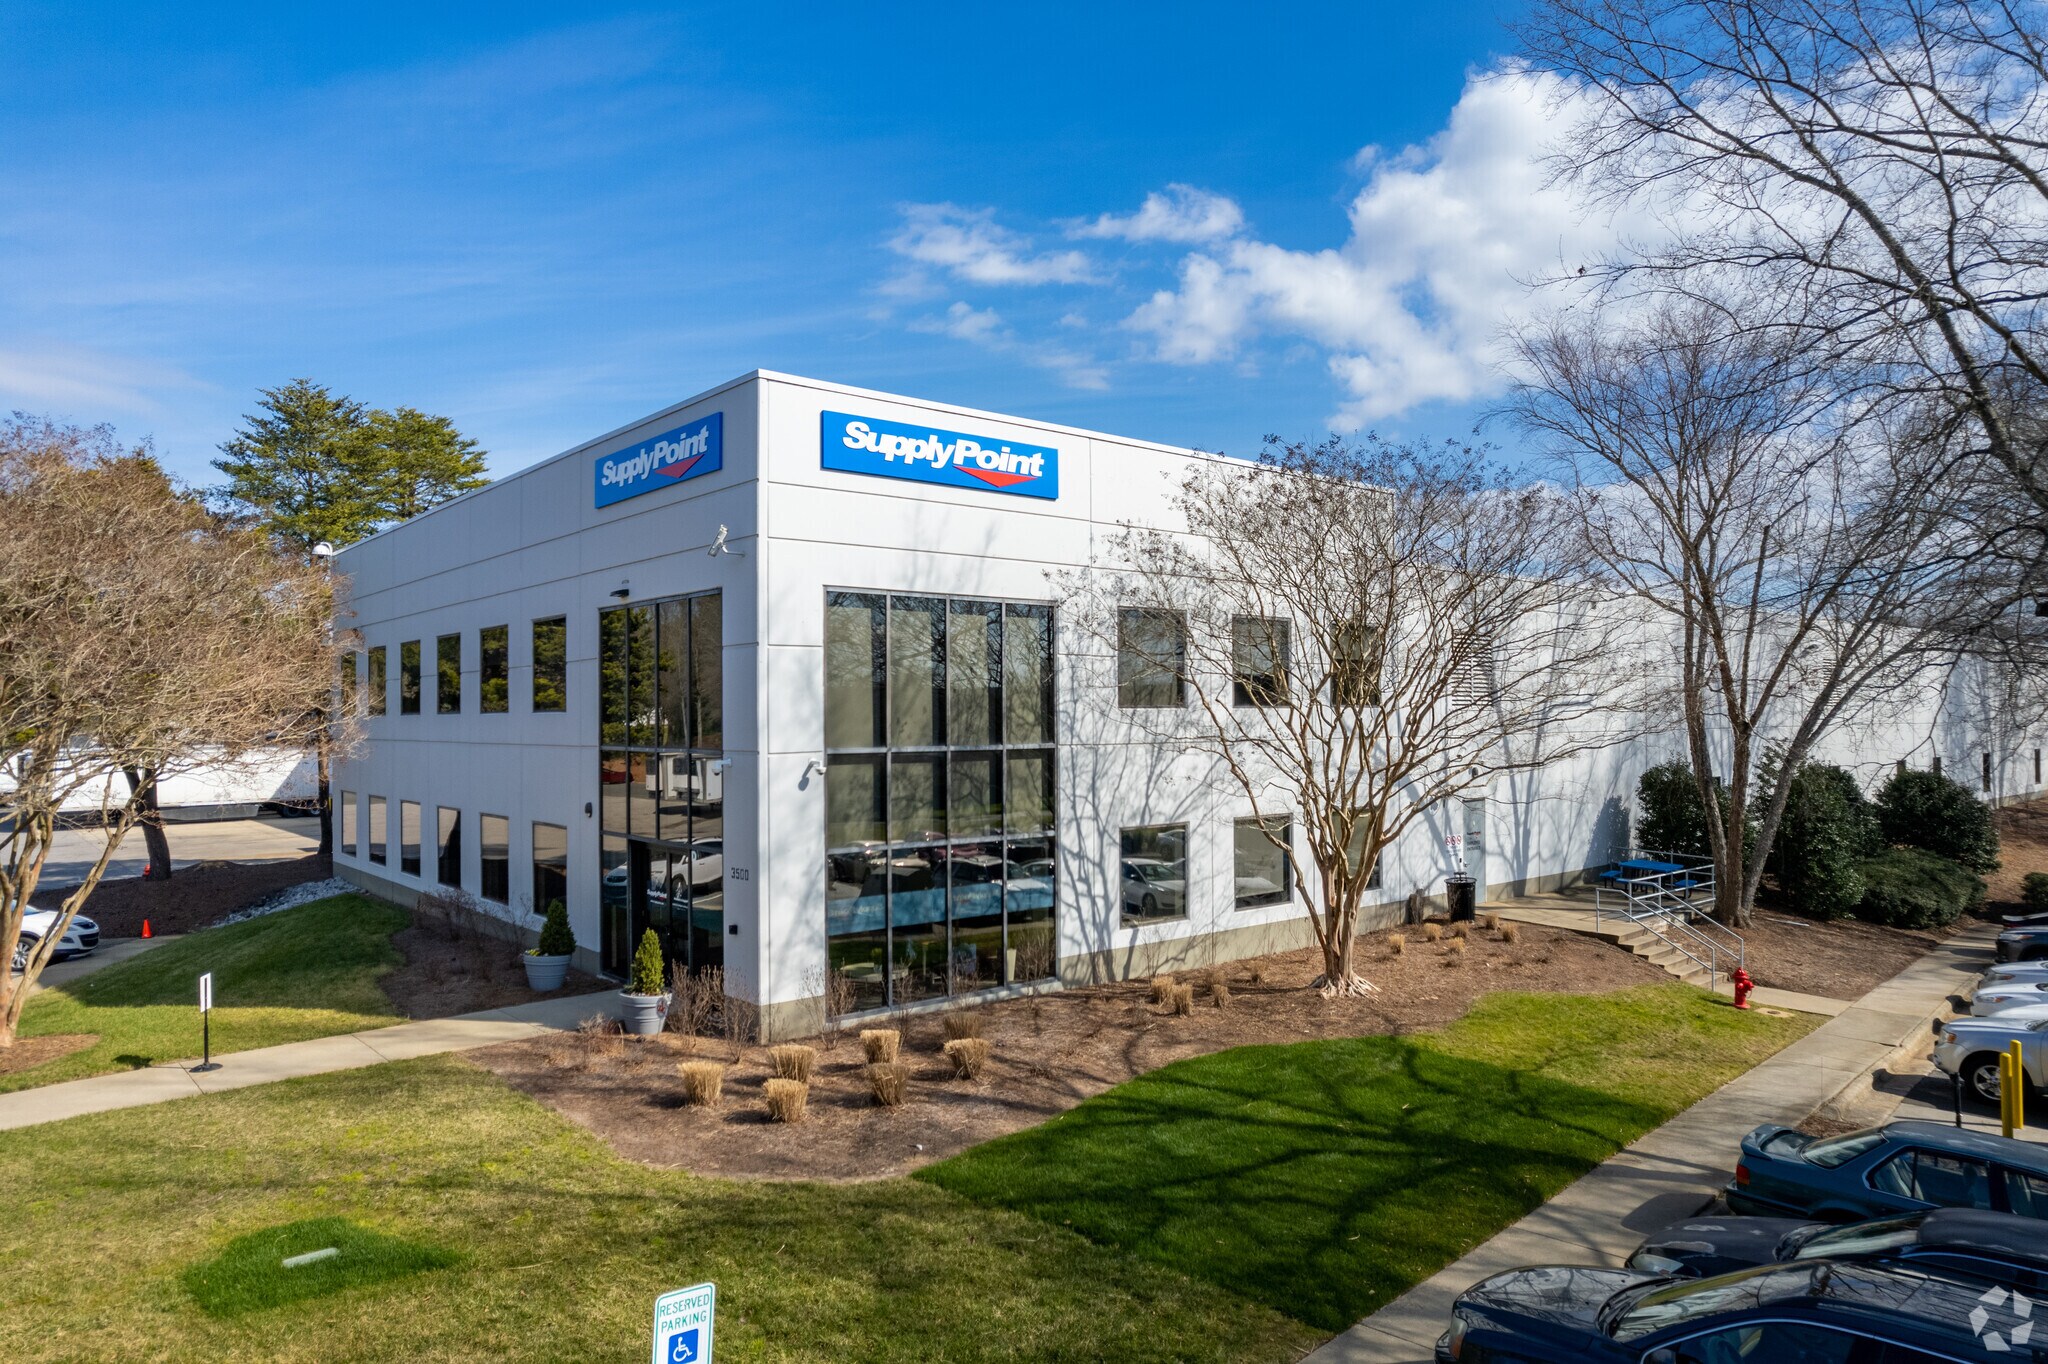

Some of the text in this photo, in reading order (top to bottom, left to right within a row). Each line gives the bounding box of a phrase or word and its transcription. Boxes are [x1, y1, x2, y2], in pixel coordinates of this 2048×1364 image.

[601, 424, 709, 487] SupplyPoint
[842, 421, 1044, 477] SupplyPoint
[731, 867, 749, 881] 3500
[660, 1294, 709, 1317] RESERVED
[661, 1310, 706, 1333] PARKING
